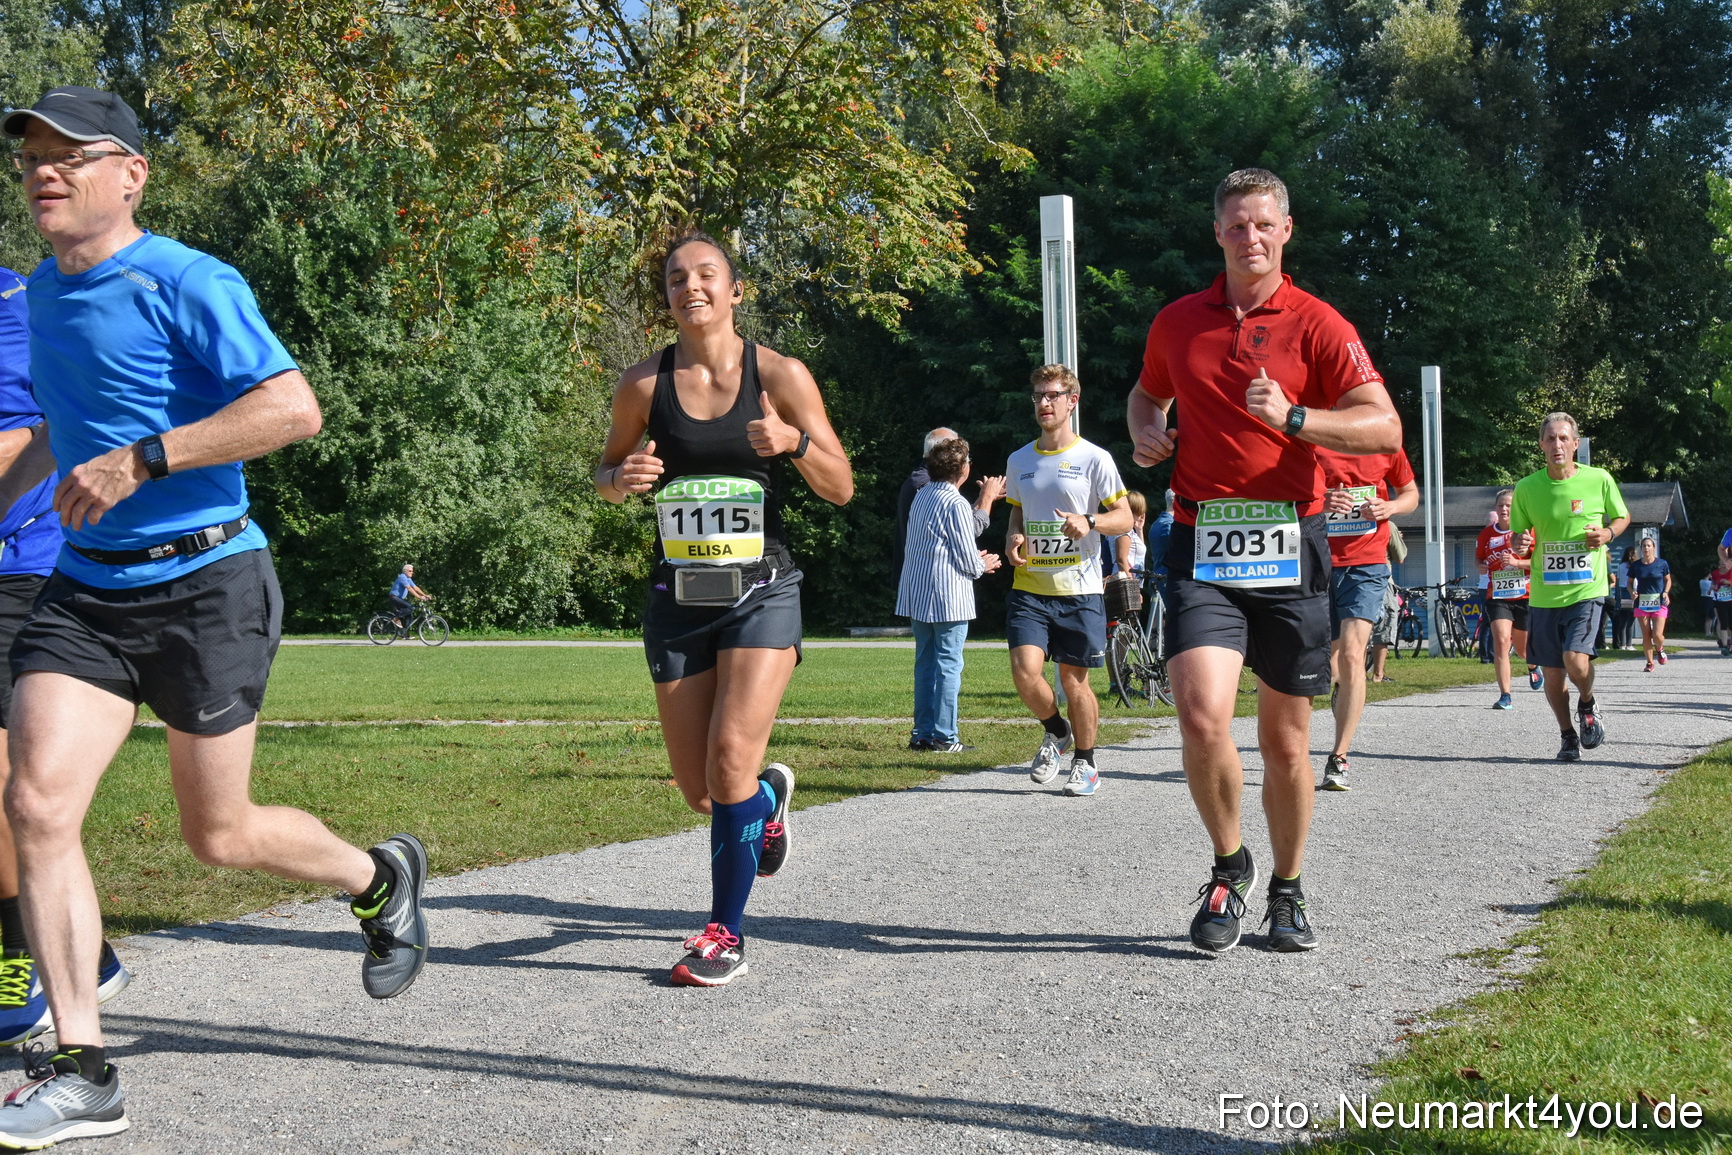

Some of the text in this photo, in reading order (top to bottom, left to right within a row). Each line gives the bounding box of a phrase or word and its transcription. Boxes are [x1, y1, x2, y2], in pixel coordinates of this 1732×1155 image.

[1059, 461, 1070, 469] 20
[664, 478, 754, 500] BOCK
[1204, 502, 1289, 523] BOCK
[671, 507, 750, 534] 1115
[1029, 523, 1064, 535] BOC
[1329, 522, 1371, 532] REINHARD
[1032, 538, 1075, 554] 1272
[1207, 529, 1284, 558] 2031
[1545, 542, 1587, 553] BOCK
[688, 544, 733, 556] ELISA
[1031, 557, 1076, 565] CHRISTOPH
[1547, 555, 1587, 570] 2816
[1215, 564, 1279, 578] ROLAND
[1494, 571, 1521, 579] BOCK
[1496, 579, 1521, 590] 2261
[739, 831, 762, 843] cep
